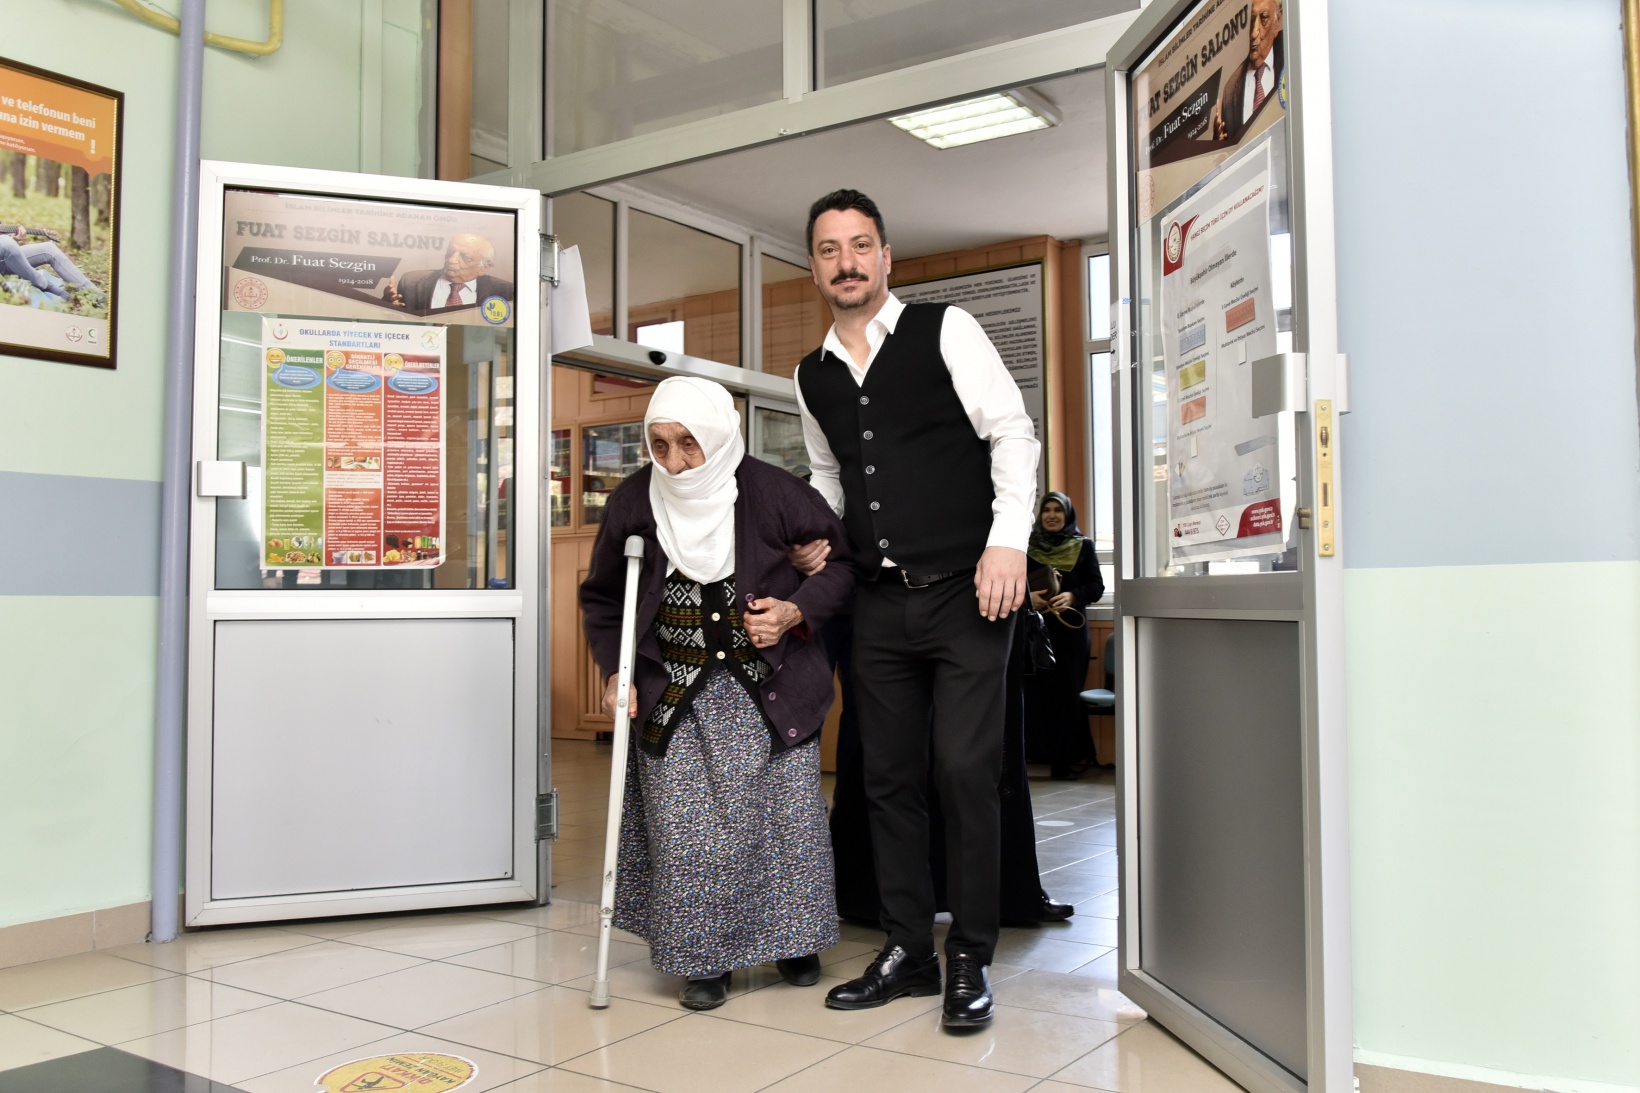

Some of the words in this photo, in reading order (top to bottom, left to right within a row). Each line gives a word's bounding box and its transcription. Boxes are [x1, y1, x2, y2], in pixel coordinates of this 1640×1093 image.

[1163, 54, 1199, 103] SEZGİN
[1201, 4, 1249, 67] SALONU
[2, 96, 15, 107] ve
[17, 99, 70, 121] telefonun
[72, 112, 96, 128] beni
[1163, 117, 1181, 139] Fuat
[1181, 92, 1208, 122] Sezgin
[19, 114, 39, 129] izin
[41, 122, 86, 141] vermem
[285, 201, 312, 211] İSLAM
[236, 220, 287, 239] FUAT
[292, 224, 362, 245] SEZGİN
[366, 231, 445, 251] SALONU
[251, 255, 272, 264] Prof.
[274, 257, 290, 265] Dr.
[292, 254, 326, 268] Fuat
[329, 257, 376, 273] Sezgin
[338, 278, 374, 286] 1924-2018
[299, 328, 341, 338] OKULLARDA
[343, 329, 372, 339] YİYECEK
[374, 332, 383, 340] VE
[384, 331, 410, 341] İÇECEK
[329, 340, 381, 349] STANDARTLARI
[286, 355, 324, 365] ÖNERİLENLER
[350, 353, 376, 361] DİKKATLİ
[404, 360, 440, 369] ÖNERİLMEYENLER
[386, 1056, 419, 1070] ZEMİN
[415, 1067, 457, 1084] KAYGAN
